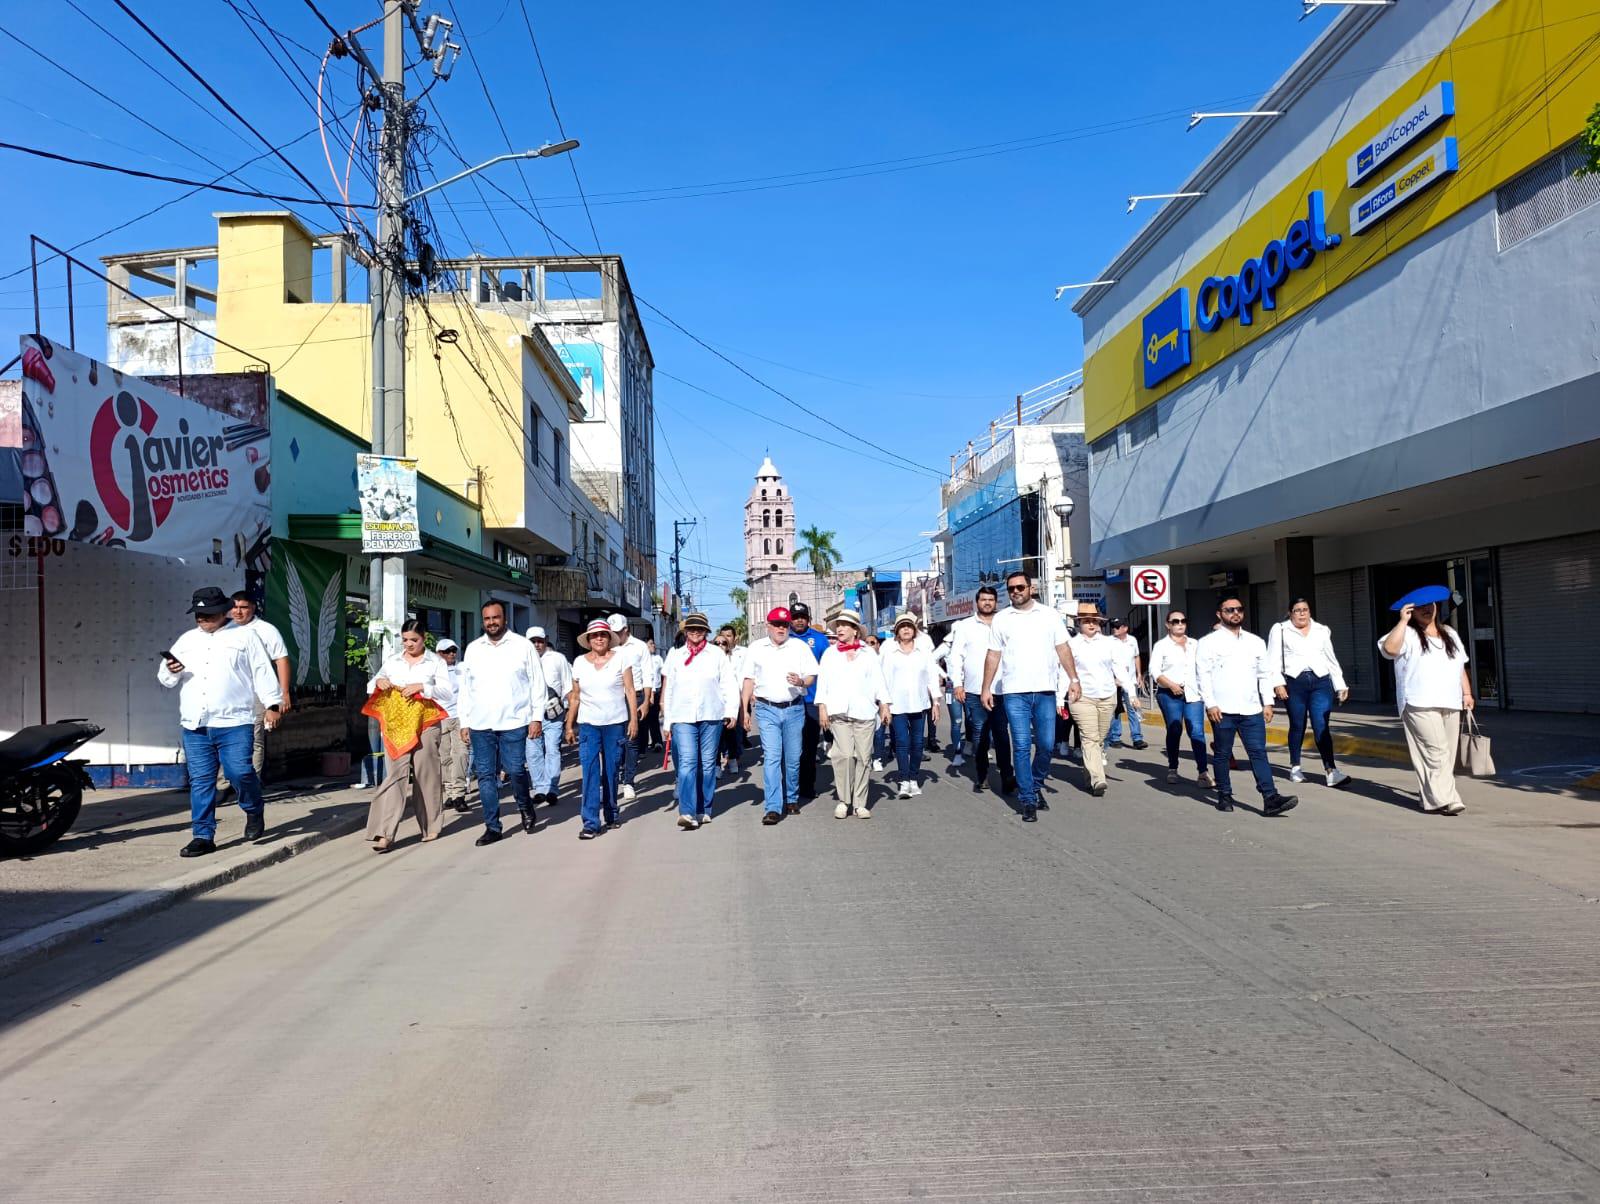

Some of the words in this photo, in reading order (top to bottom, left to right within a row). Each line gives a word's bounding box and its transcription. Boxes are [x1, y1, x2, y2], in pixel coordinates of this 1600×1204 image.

[1375, 105, 1430, 156] BanCoppel
[1372, 189, 1394, 212] Afore
[1398, 163, 1430, 191] Coppel
[1196, 189, 1326, 333] Coppel
[364, 540, 381, 549] DEL
[383, 540, 395, 549] 15
[395, 540, 409, 549] AL
[371, 531, 412, 541] FEBRERO
[1143, 576, 1158, 594] E
